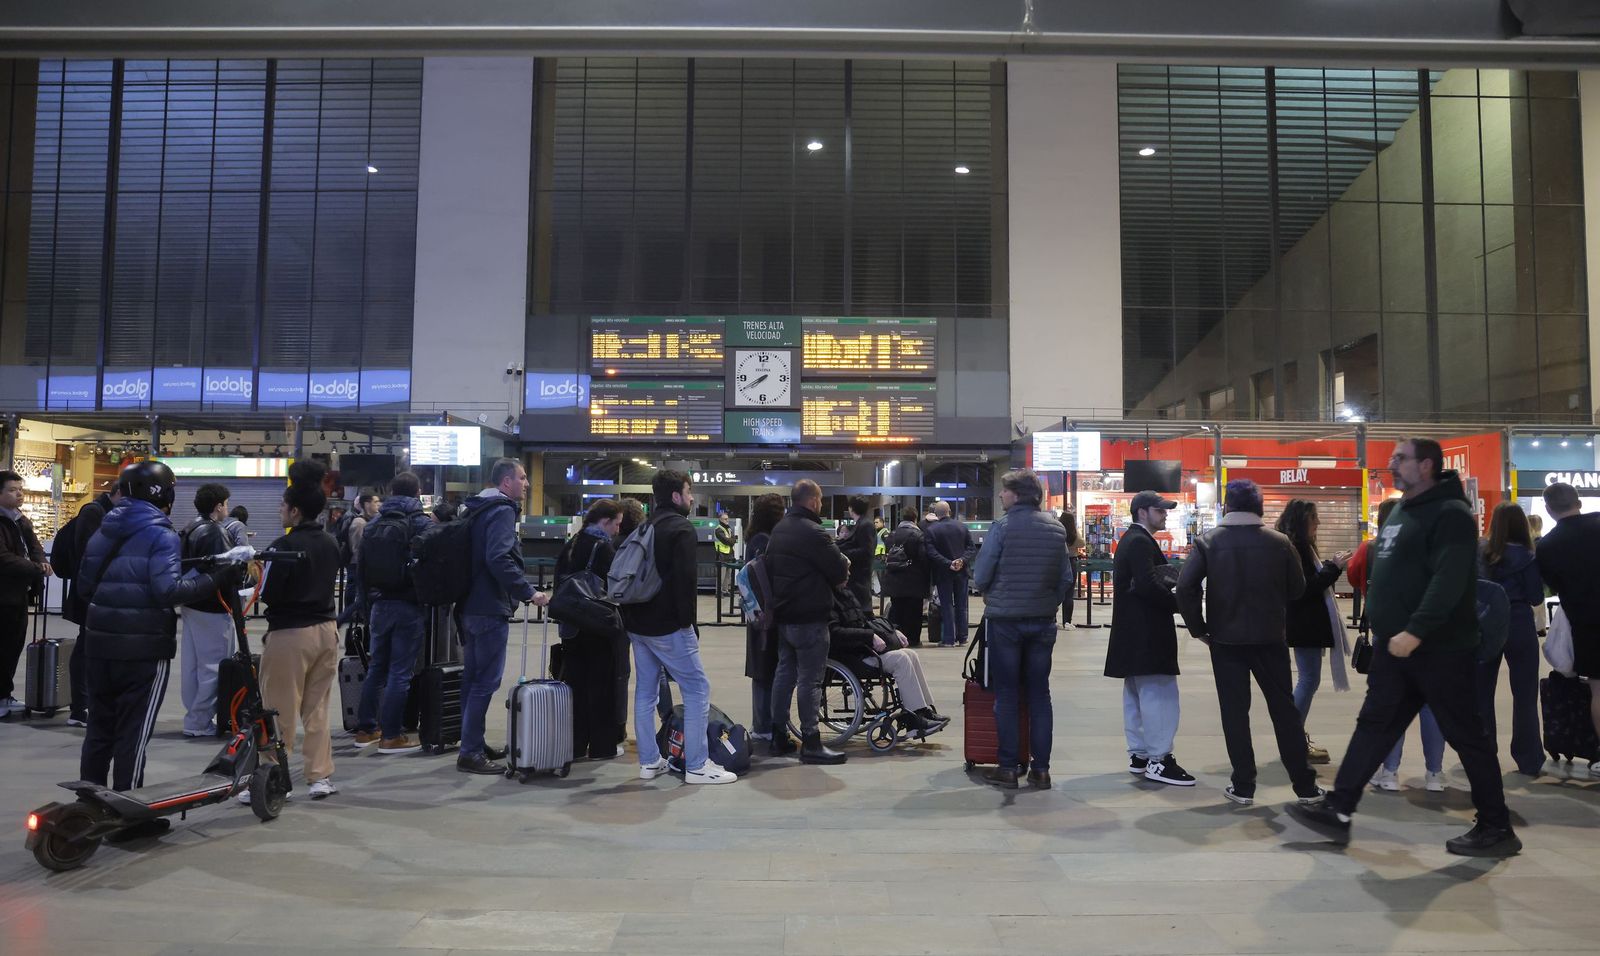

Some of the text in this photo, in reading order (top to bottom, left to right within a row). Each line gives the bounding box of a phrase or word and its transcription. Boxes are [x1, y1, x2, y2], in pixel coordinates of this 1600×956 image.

[743, 321, 784, 330] TRENES ALTA
[746, 331, 780, 340] VELOCIDAD
[758, 355, 769, 363] 12
[740, 374, 747, 382] 9
[779, 374, 787, 382] 3
[759, 394, 767, 402] 6
[743, 418, 783, 427] HIGH SPEED
[751, 428, 775, 437] TRAINS
[1280, 469, 1307, 484] RELAY
[1544, 472, 1600, 489] CHAN
